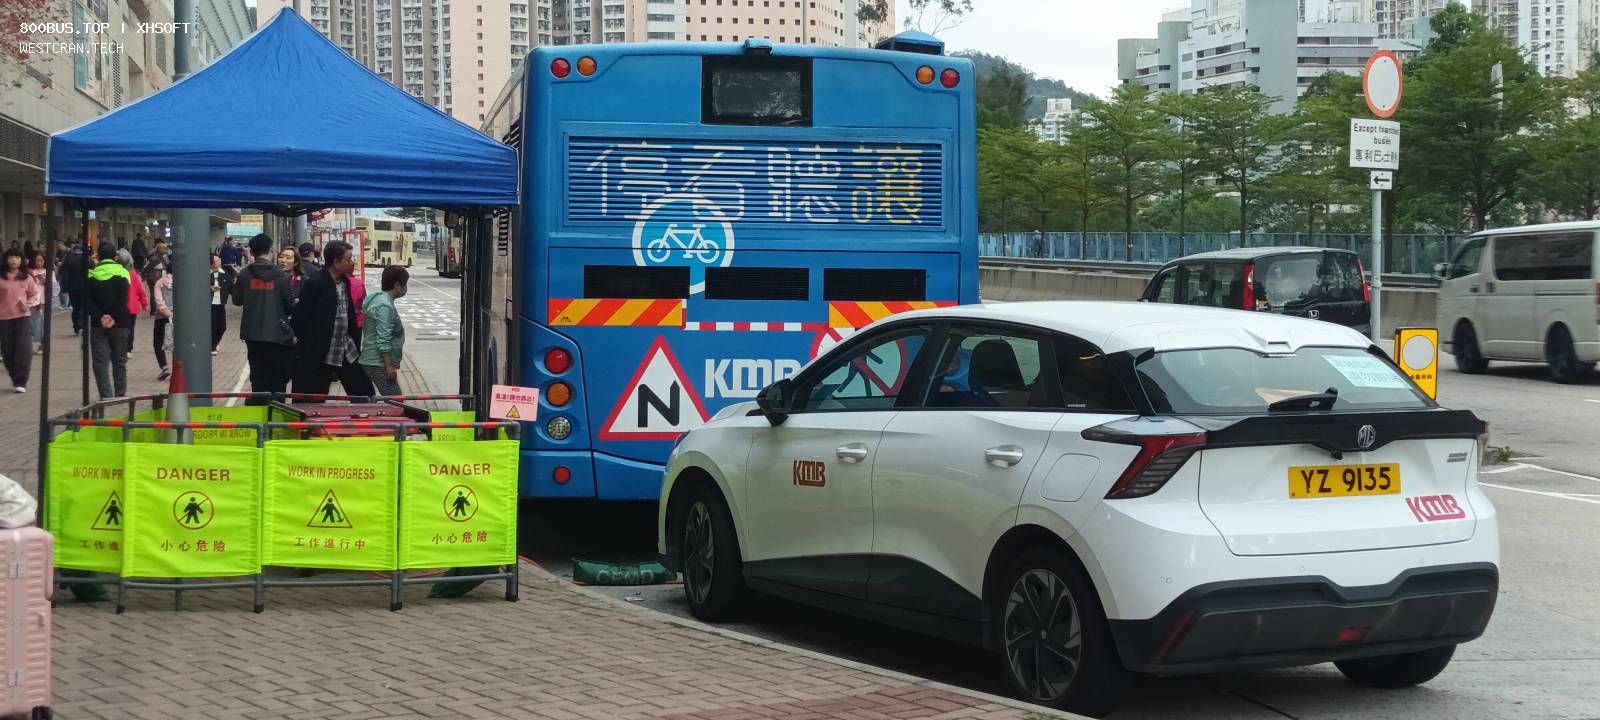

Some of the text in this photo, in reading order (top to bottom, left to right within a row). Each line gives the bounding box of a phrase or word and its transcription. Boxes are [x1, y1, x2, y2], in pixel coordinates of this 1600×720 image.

[1353, 123, 1377, 134] Except
[73, 466, 99, 479] WORK
[101, 467, 111, 479] IN
[156, 467, 230, 481] DANGER
[288, 466, 375, 480] WORK IN PROGRESS
[429, 463, 491, 475] DANGER
[793, 460, 826, 487] KMB
[1301, 467, 1391, 493] YZ 9135
[1405, 494, 1466, 522] KMB
[293, 537, 366, 550] 工作進行中
[432, 530, 488, 544] 小心危險
[160, 539, 226, 552] 小心危險
